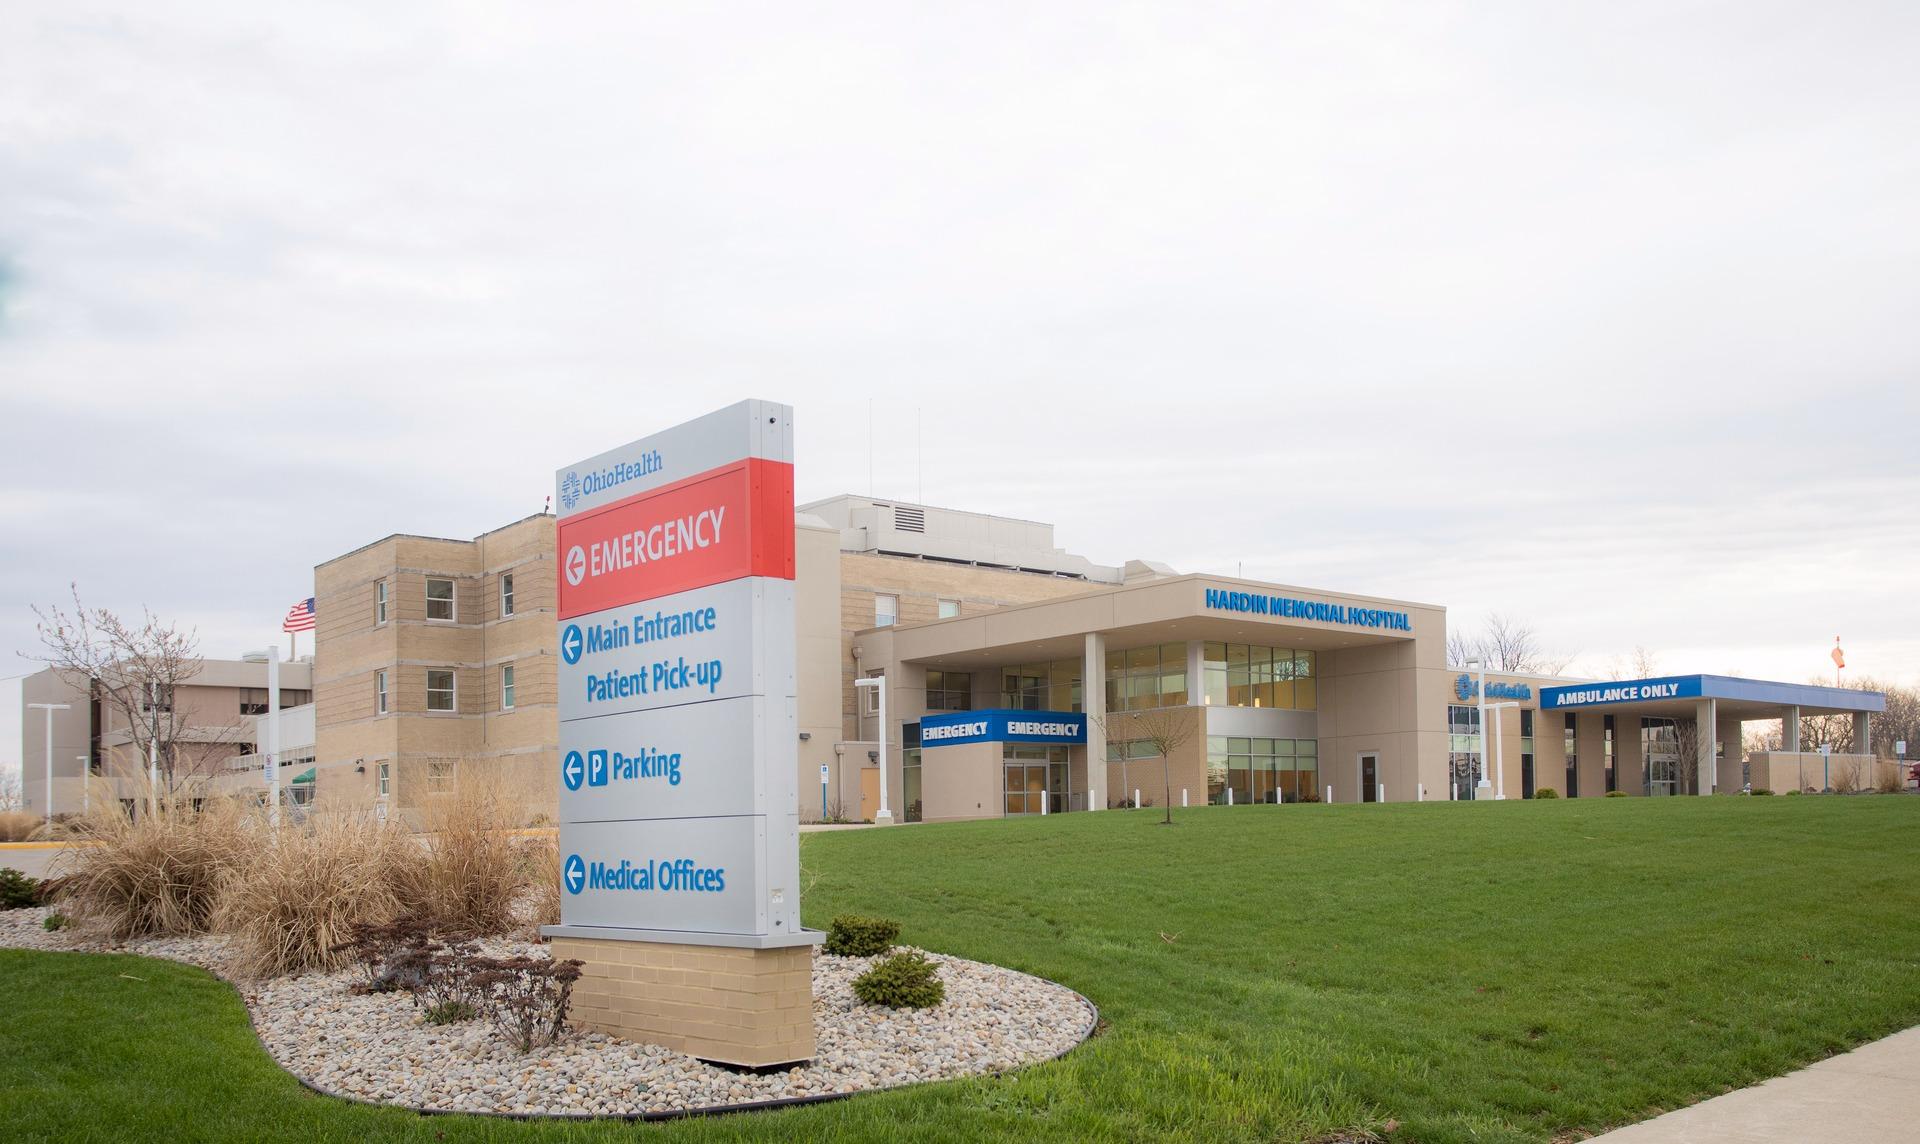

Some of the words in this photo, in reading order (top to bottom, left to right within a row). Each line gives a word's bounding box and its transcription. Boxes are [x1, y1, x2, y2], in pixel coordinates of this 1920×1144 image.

[583, 450, 662, 495] OhioHealth
[591, 506, 725, 576] EMERGENCY
[586, 620, 629, 653] Main
[634, 606, 716, 645] Entrance
[1206, 588, 1268, 614] HARDIN
[1270, 597, 1348, 624] MEMORIAL
[1349, 607, 1412, 631] HOSPITAL
[588, 666, 648, 702] Patient
[653, 657, 722, 692] Pick-up
[1556, 687, 1638, 705] AMBULANCE
[1640, 683, 1679, 698] ONLY
[922, 721, 988, 740] EMERGENCY
[1007, 721, 1079, 736] EMERGENCY
[592, 754, 602, 782] P
[613, 747, 682, 785] Parking
[589, 859, 654, 890] Medical
[658, 859, 725, 891] Offices
